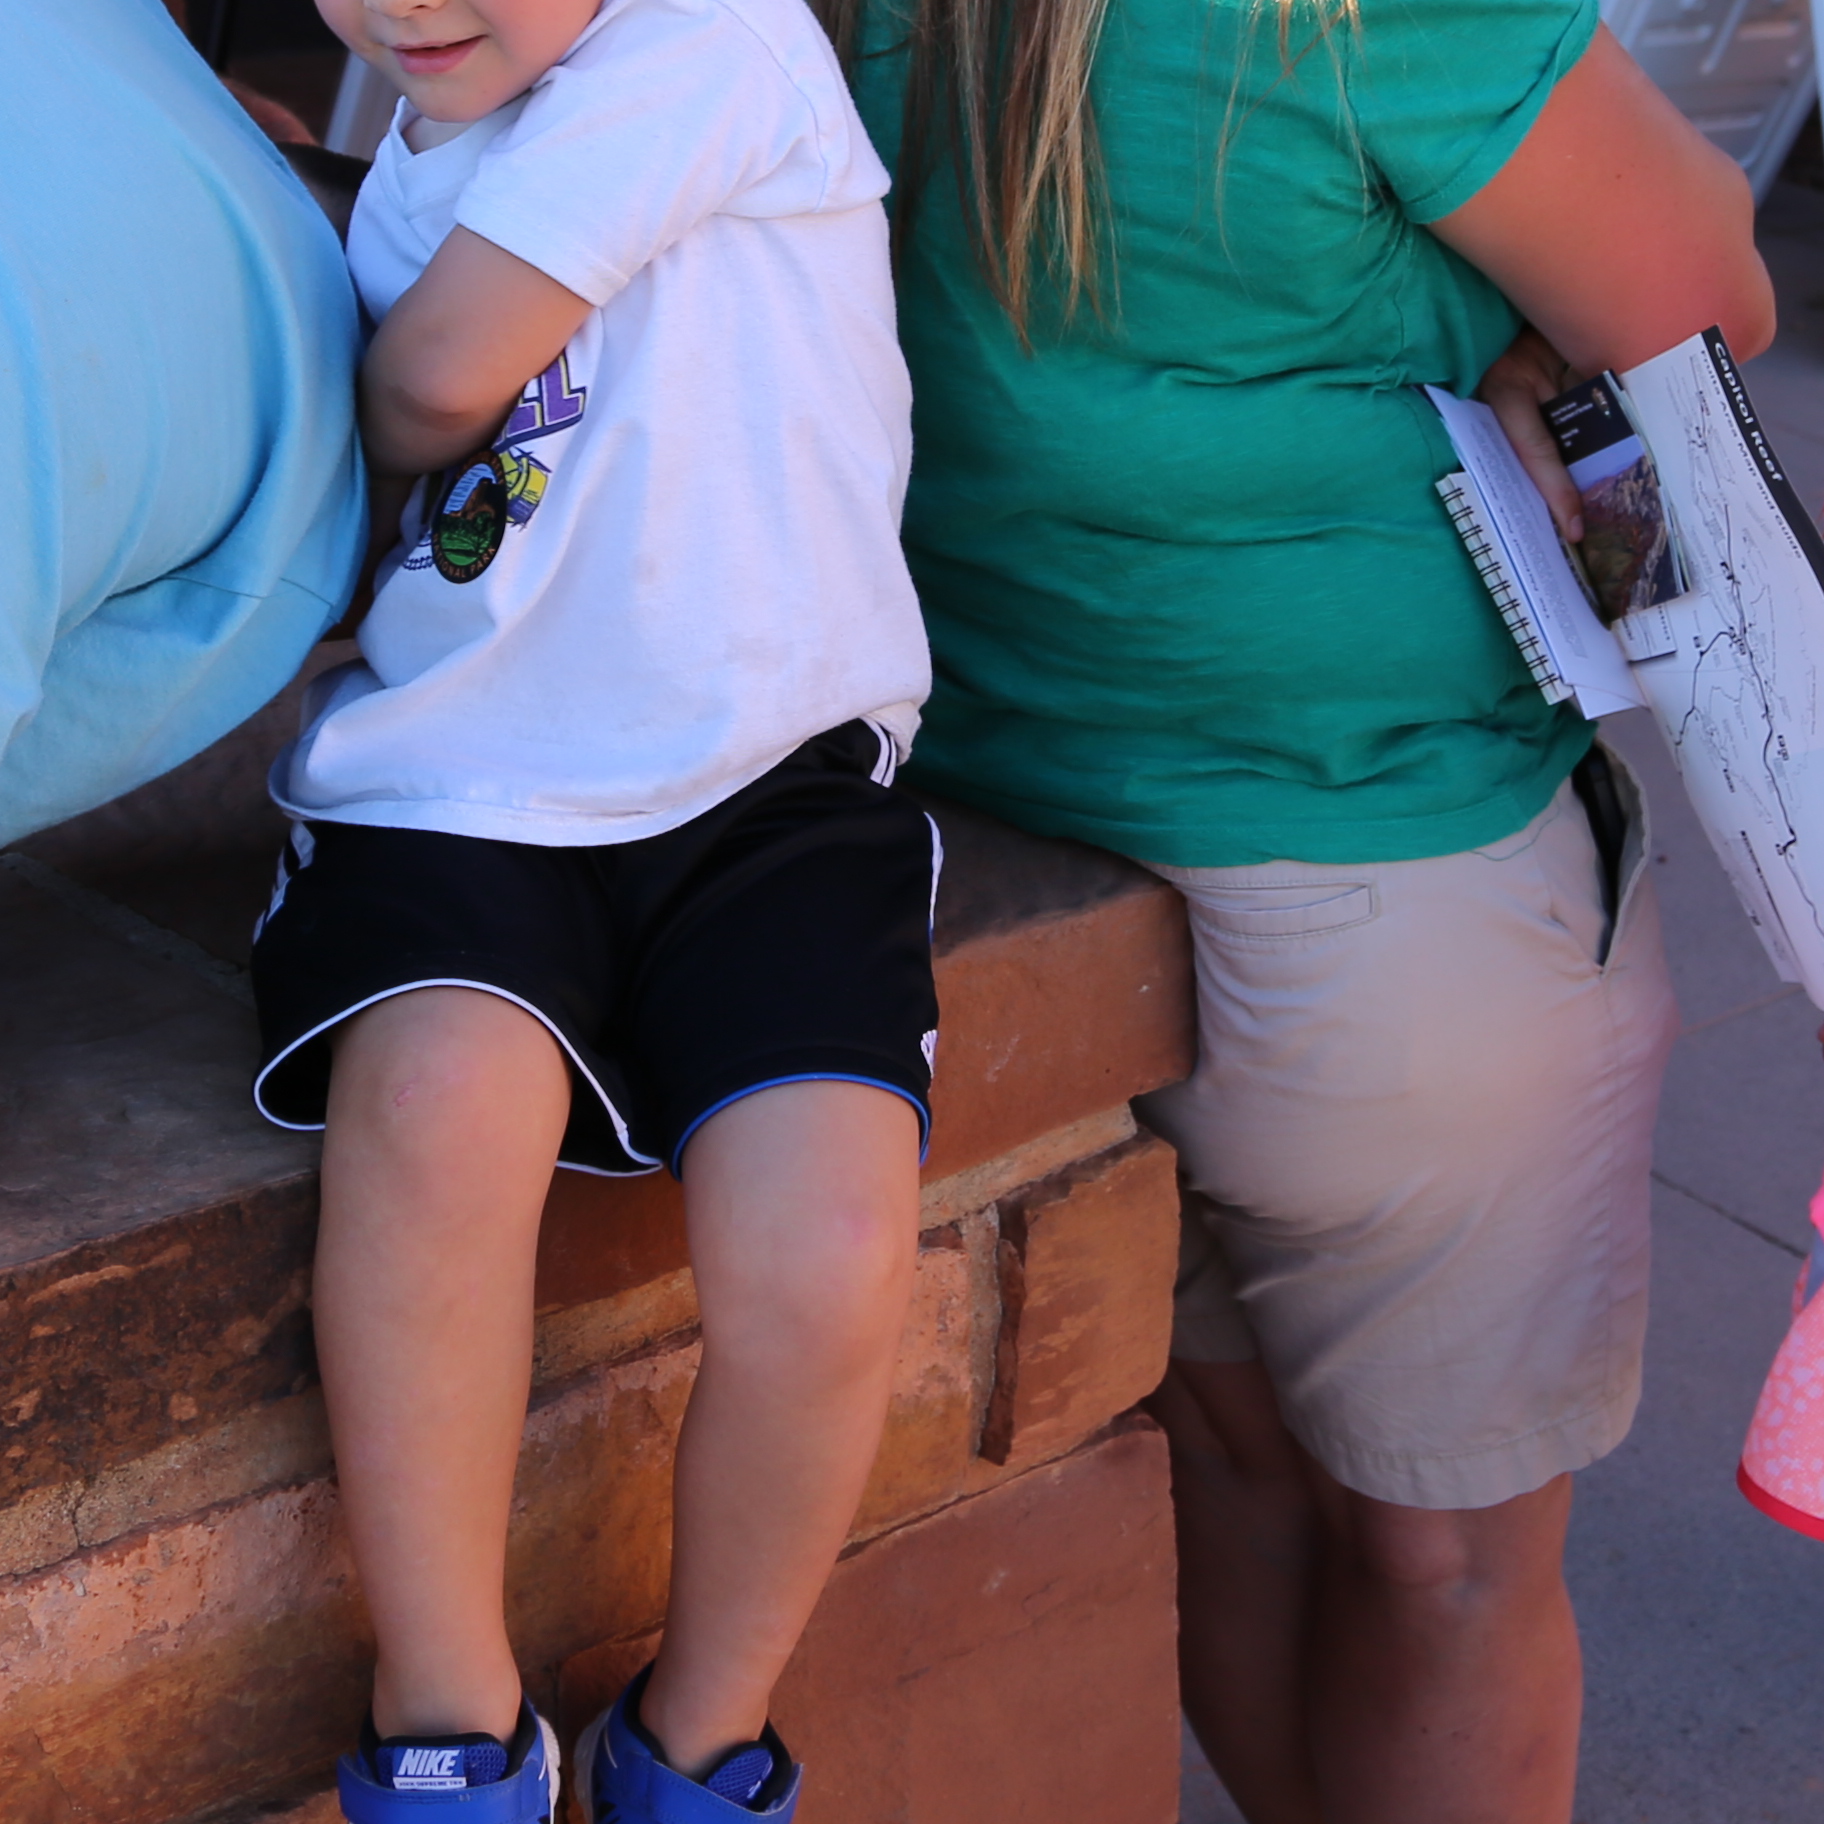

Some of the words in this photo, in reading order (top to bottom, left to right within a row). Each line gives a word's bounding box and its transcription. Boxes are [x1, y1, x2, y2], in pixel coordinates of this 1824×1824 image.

[1700, 349, 1721, 396] Fruita
[1720, 400, 1739, 438] Area
[1738, 442, 1757, 478] Map
[1756, 480, 1775, 511] and
[1775, 514, 1803, 559] Guide
[1715, 342, 1754, 425] Capitol
[1750, 430, 1783, 480] Reef
[397, 1748, 460, 1776] NIKE
